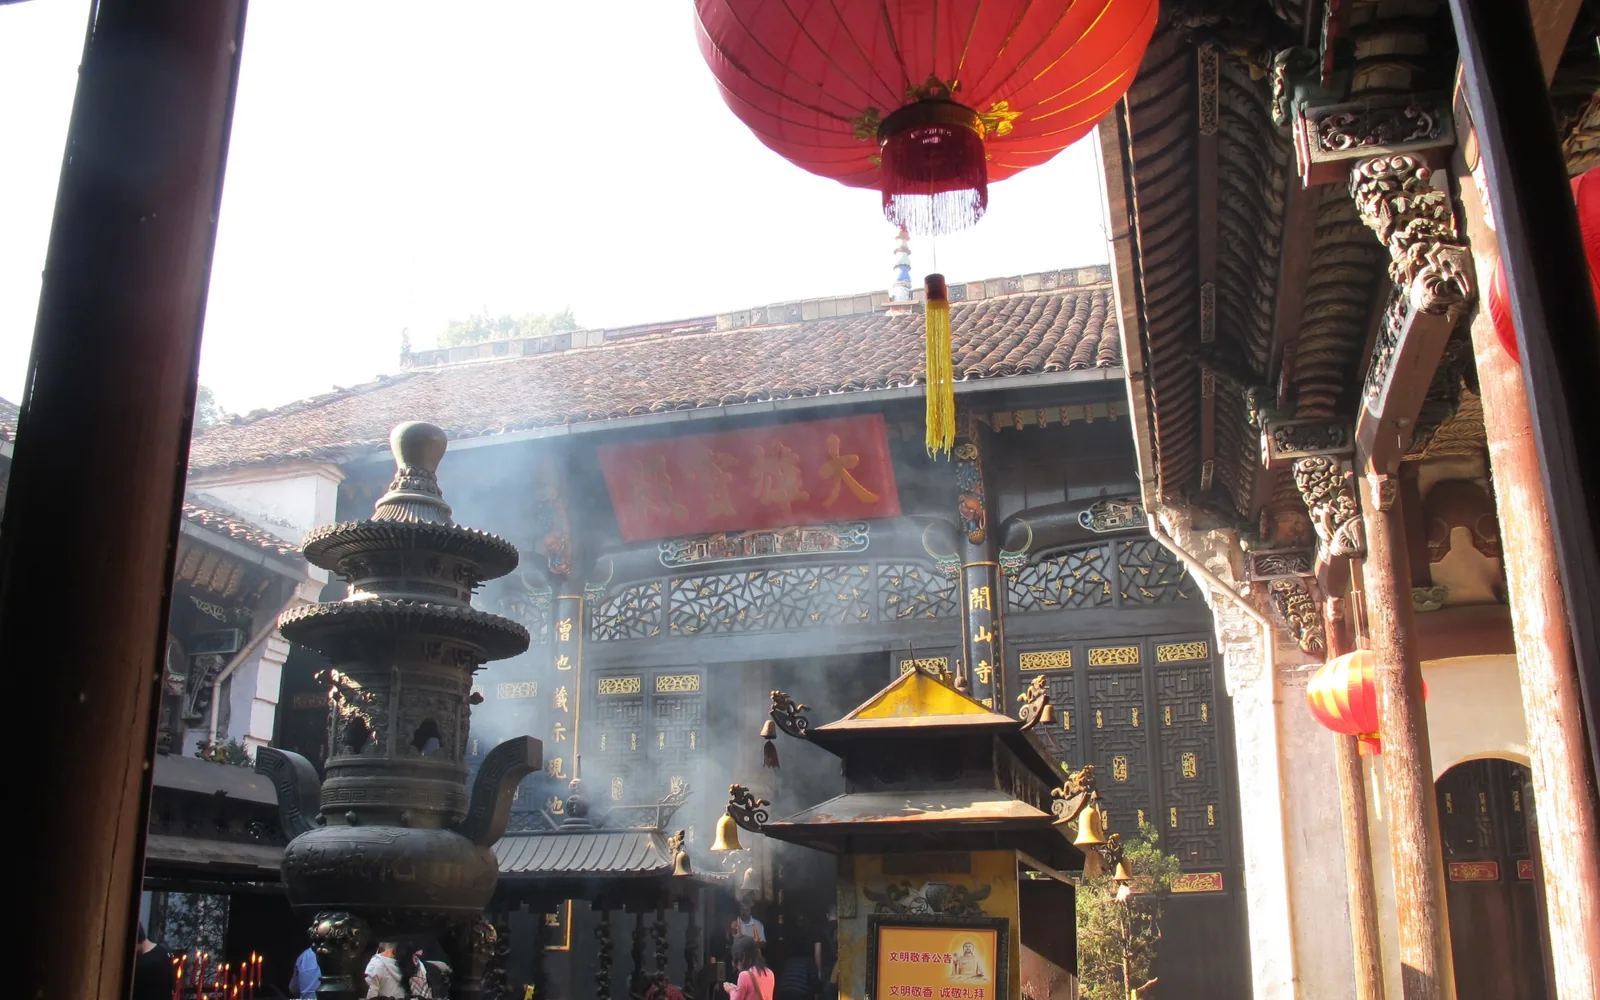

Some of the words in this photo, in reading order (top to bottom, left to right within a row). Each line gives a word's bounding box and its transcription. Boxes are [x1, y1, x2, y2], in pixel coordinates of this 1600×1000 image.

[889, 951, 953, 964] 文明敬香公告
[889, 985, 933, 998] 文明敬香
[940, 987, 985, 999] 诚敬礼拜
